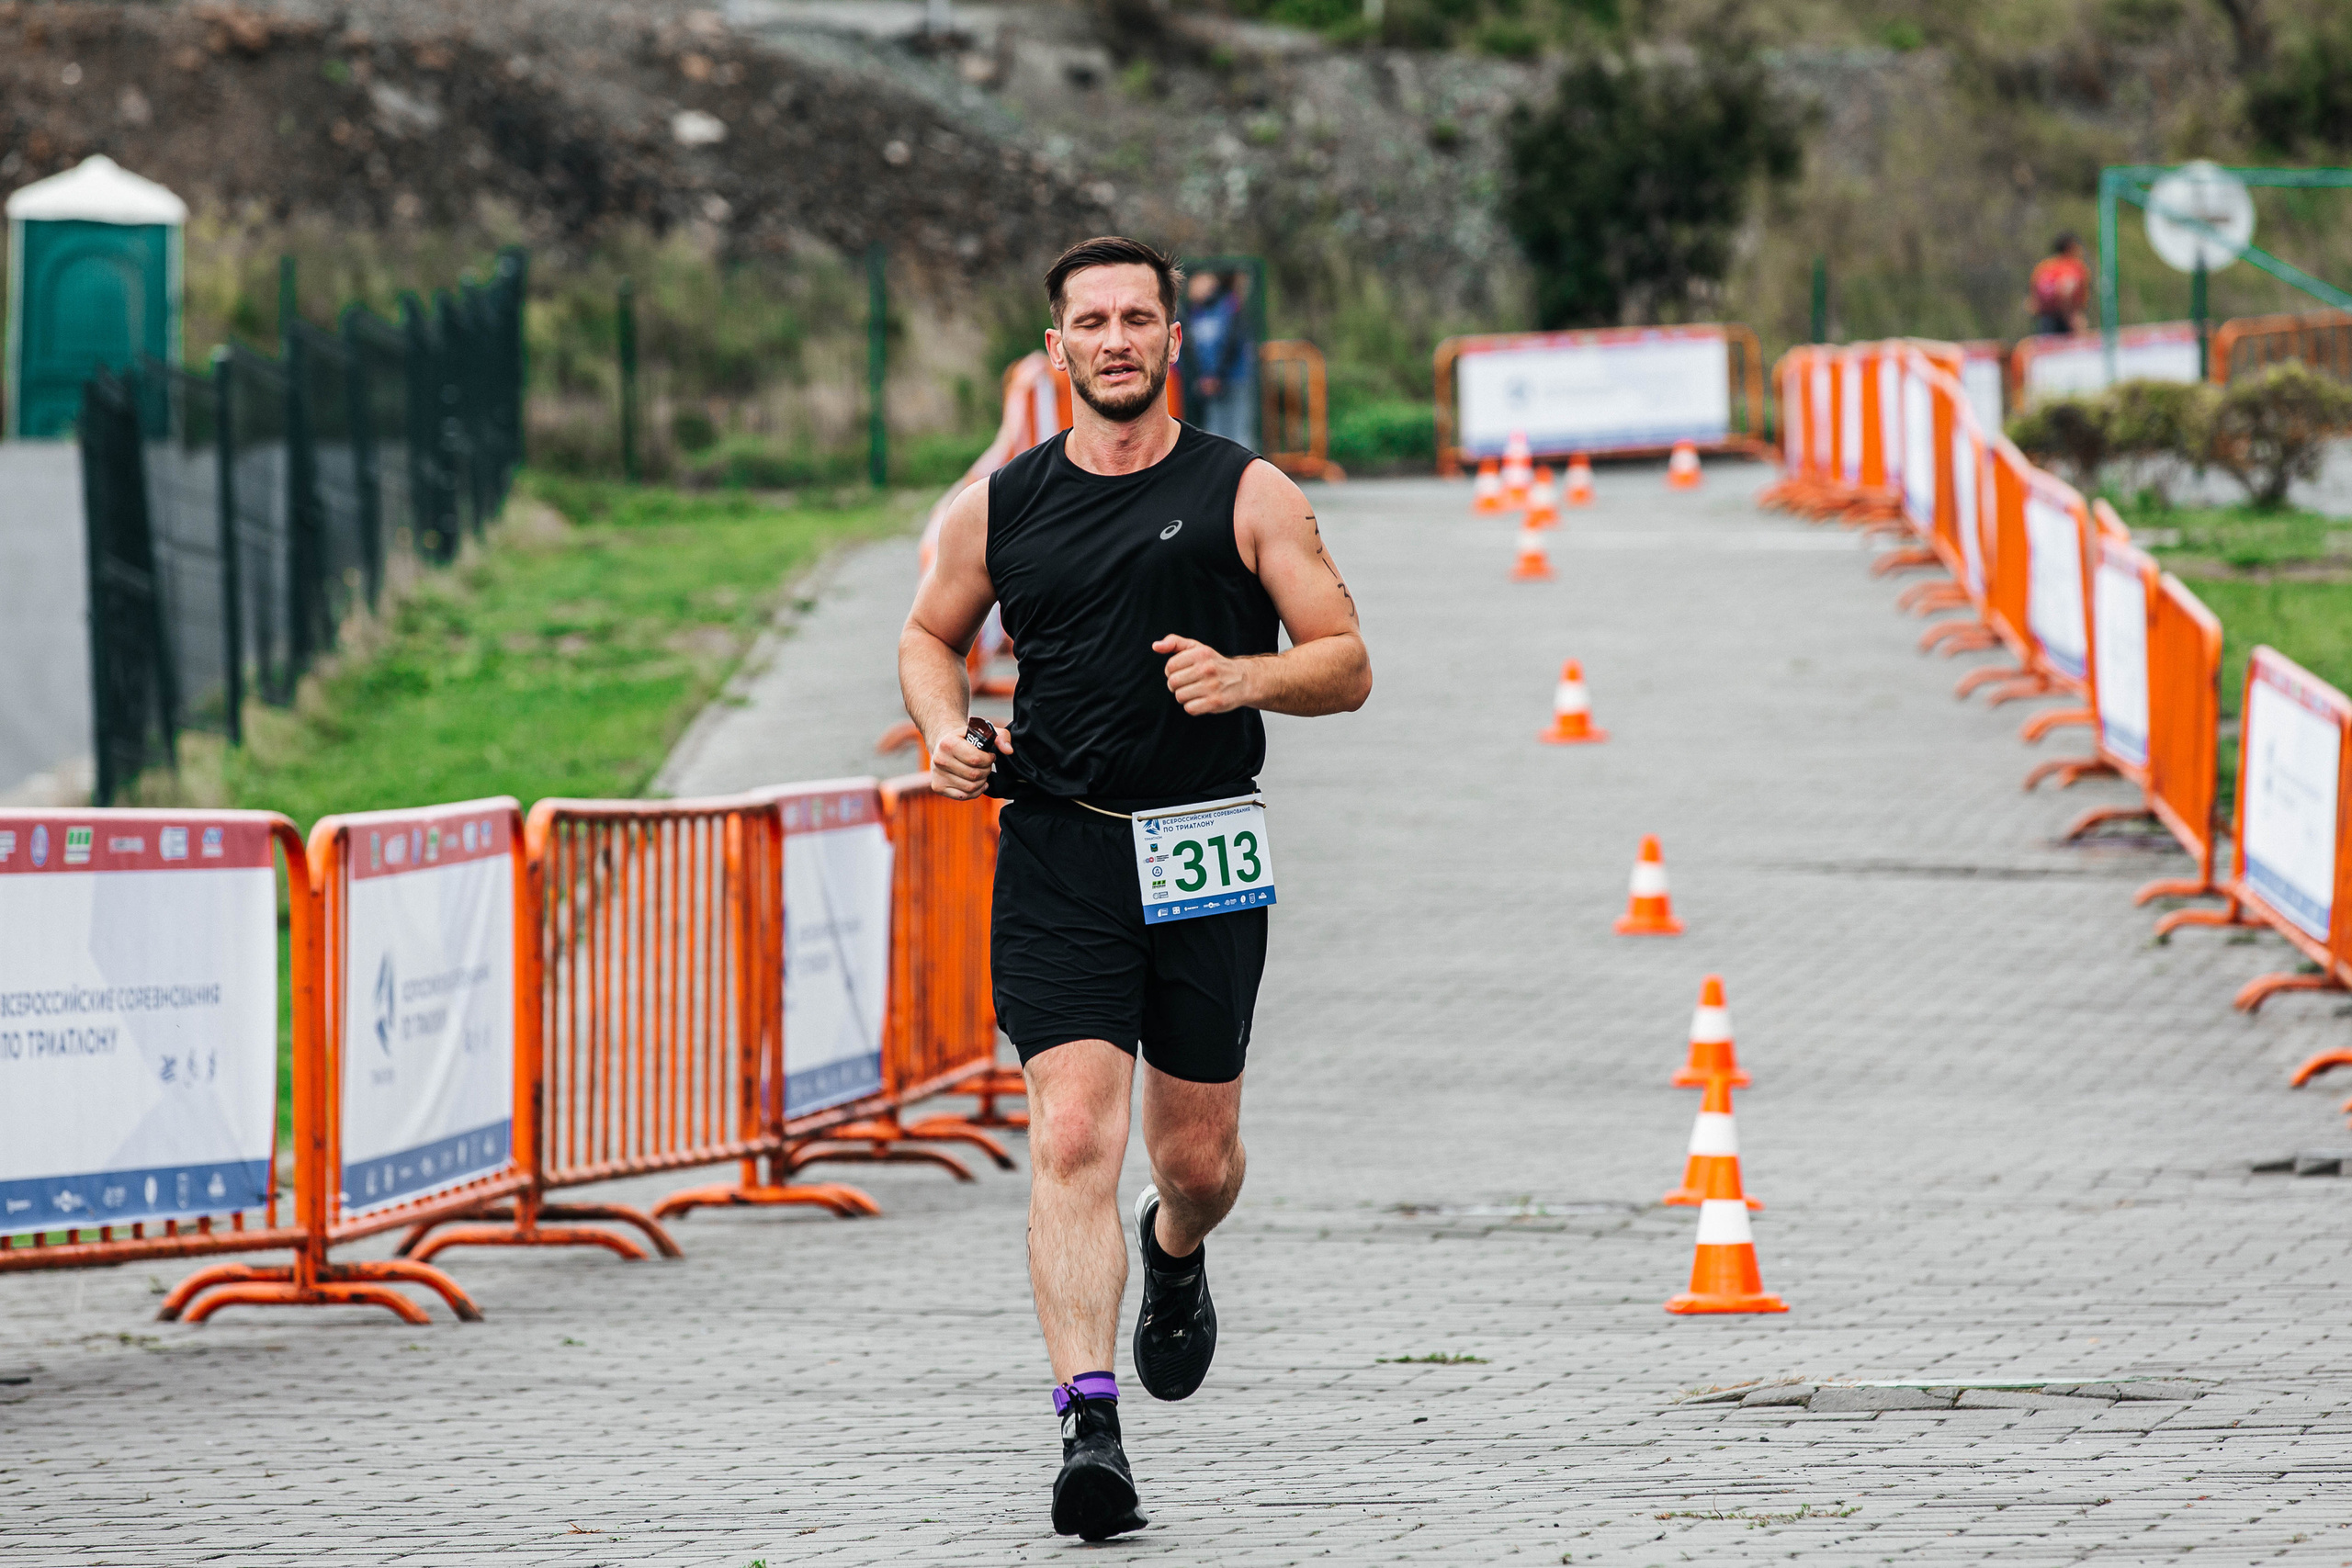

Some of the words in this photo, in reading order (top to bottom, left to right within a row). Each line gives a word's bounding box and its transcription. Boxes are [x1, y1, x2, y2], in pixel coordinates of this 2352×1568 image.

[1162, 813, 1212, 825] ВСЕРОССИЙСКИЕ
[1214, 807, 1250, 818] СОРЕВНОВАНИЯ
[1176, 820, 1215, 831] ТРИАТЛОНУ
[1172, 830, 1261, 892] 313
[27, 1027, 118, 1058] ТРИАТЛОНУ
